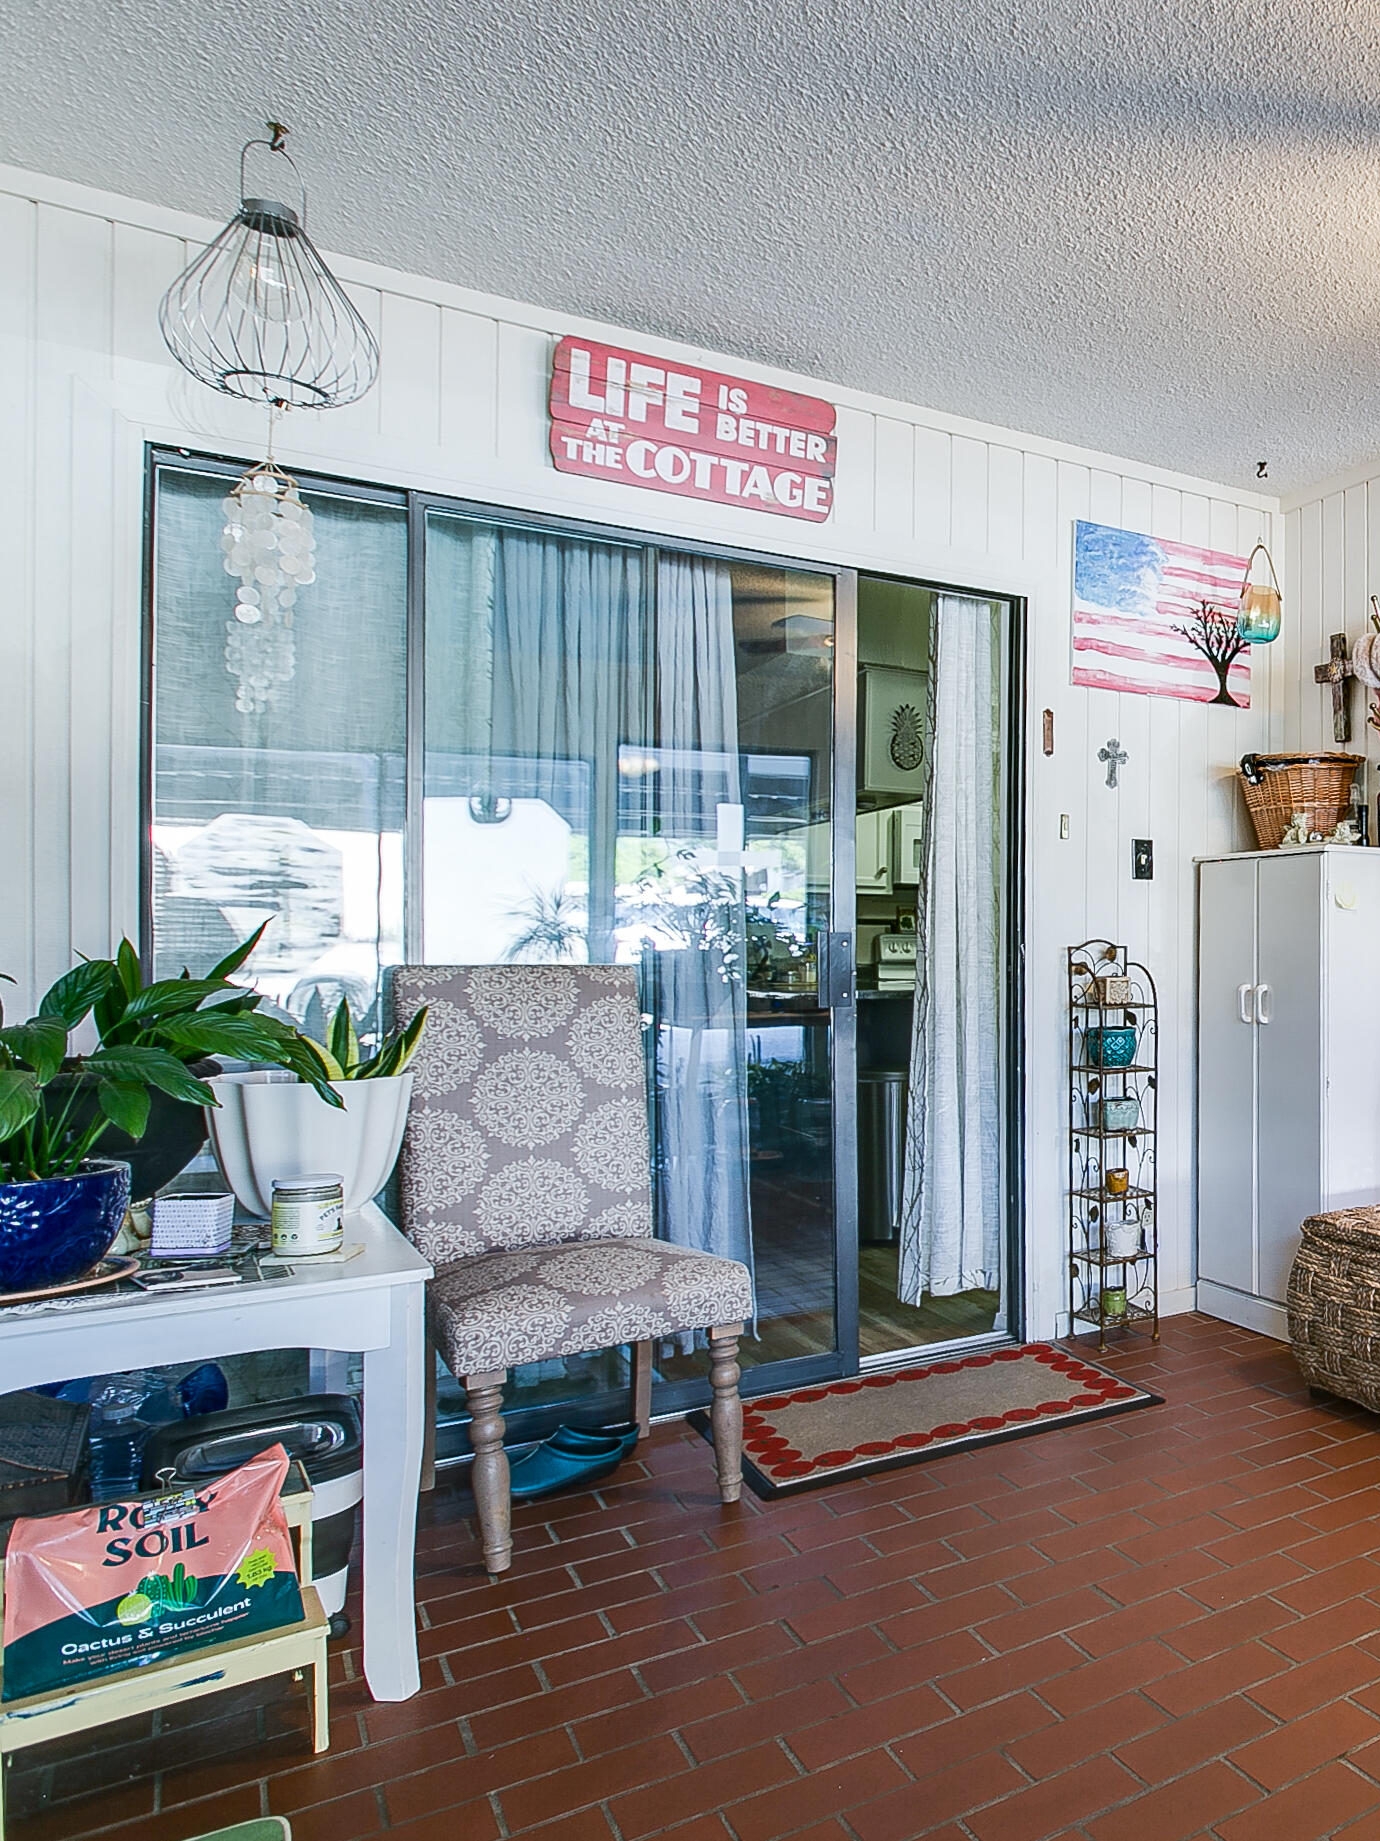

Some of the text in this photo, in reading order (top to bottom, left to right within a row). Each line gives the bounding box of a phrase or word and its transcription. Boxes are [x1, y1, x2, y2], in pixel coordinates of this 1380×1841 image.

[568, 347, 749, 435] LIFE IS
[585, 412, 827, 464] AT BETTER
[560, 435, 831, 514] THE COTTAGE
[96, 1491, 219, 1534] RY
[102, 1522, 210, 1567] SOIL
[61, 1597, 252, 1655] Cactus & Succulent
